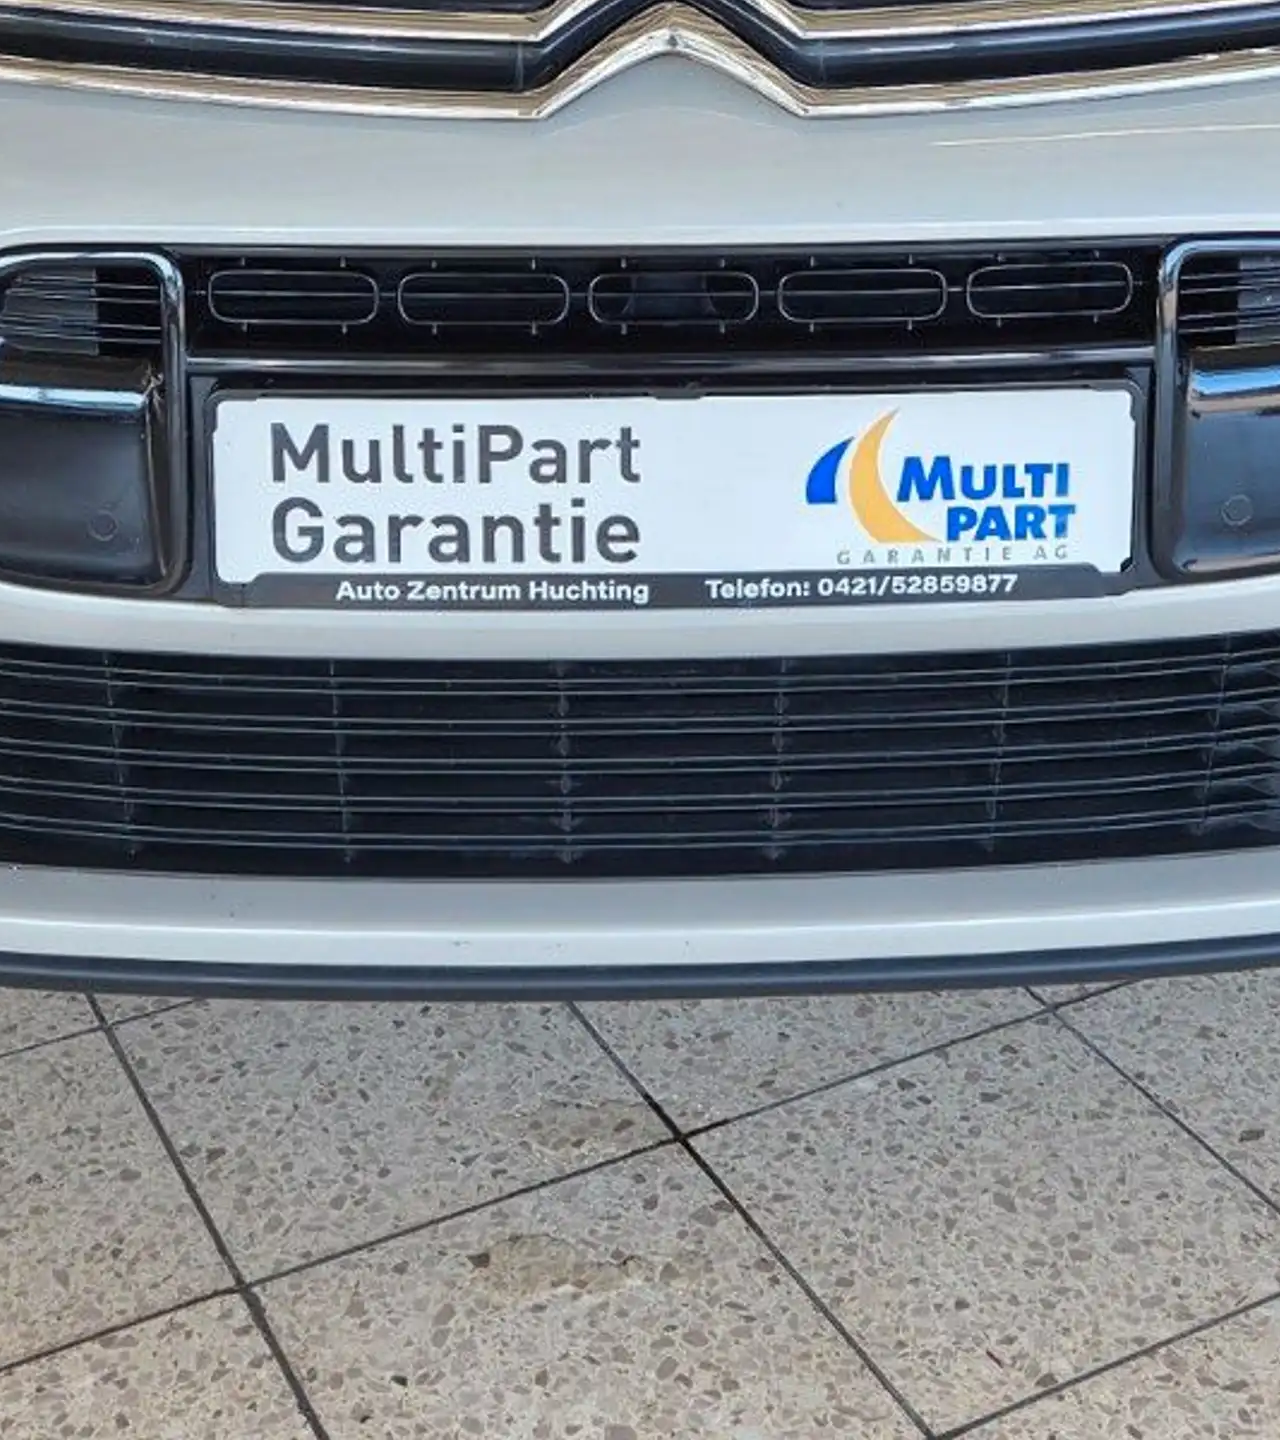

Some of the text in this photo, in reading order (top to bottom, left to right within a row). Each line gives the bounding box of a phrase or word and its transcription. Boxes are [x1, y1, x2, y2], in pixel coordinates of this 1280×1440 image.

[270, 422, 641, 484] MultiPart
[897, 456, 1070, 501] MULTI
[272, 496, 641, 564] Garantie
[946, 504, 1076, 541] PART
[836, 544, 1069, 566] GARANTIE AG
[336, 580, 650, 604] Auto Zentrum Huchting
[705, 574, 1018, 600] Telefon: 0421/52859877
